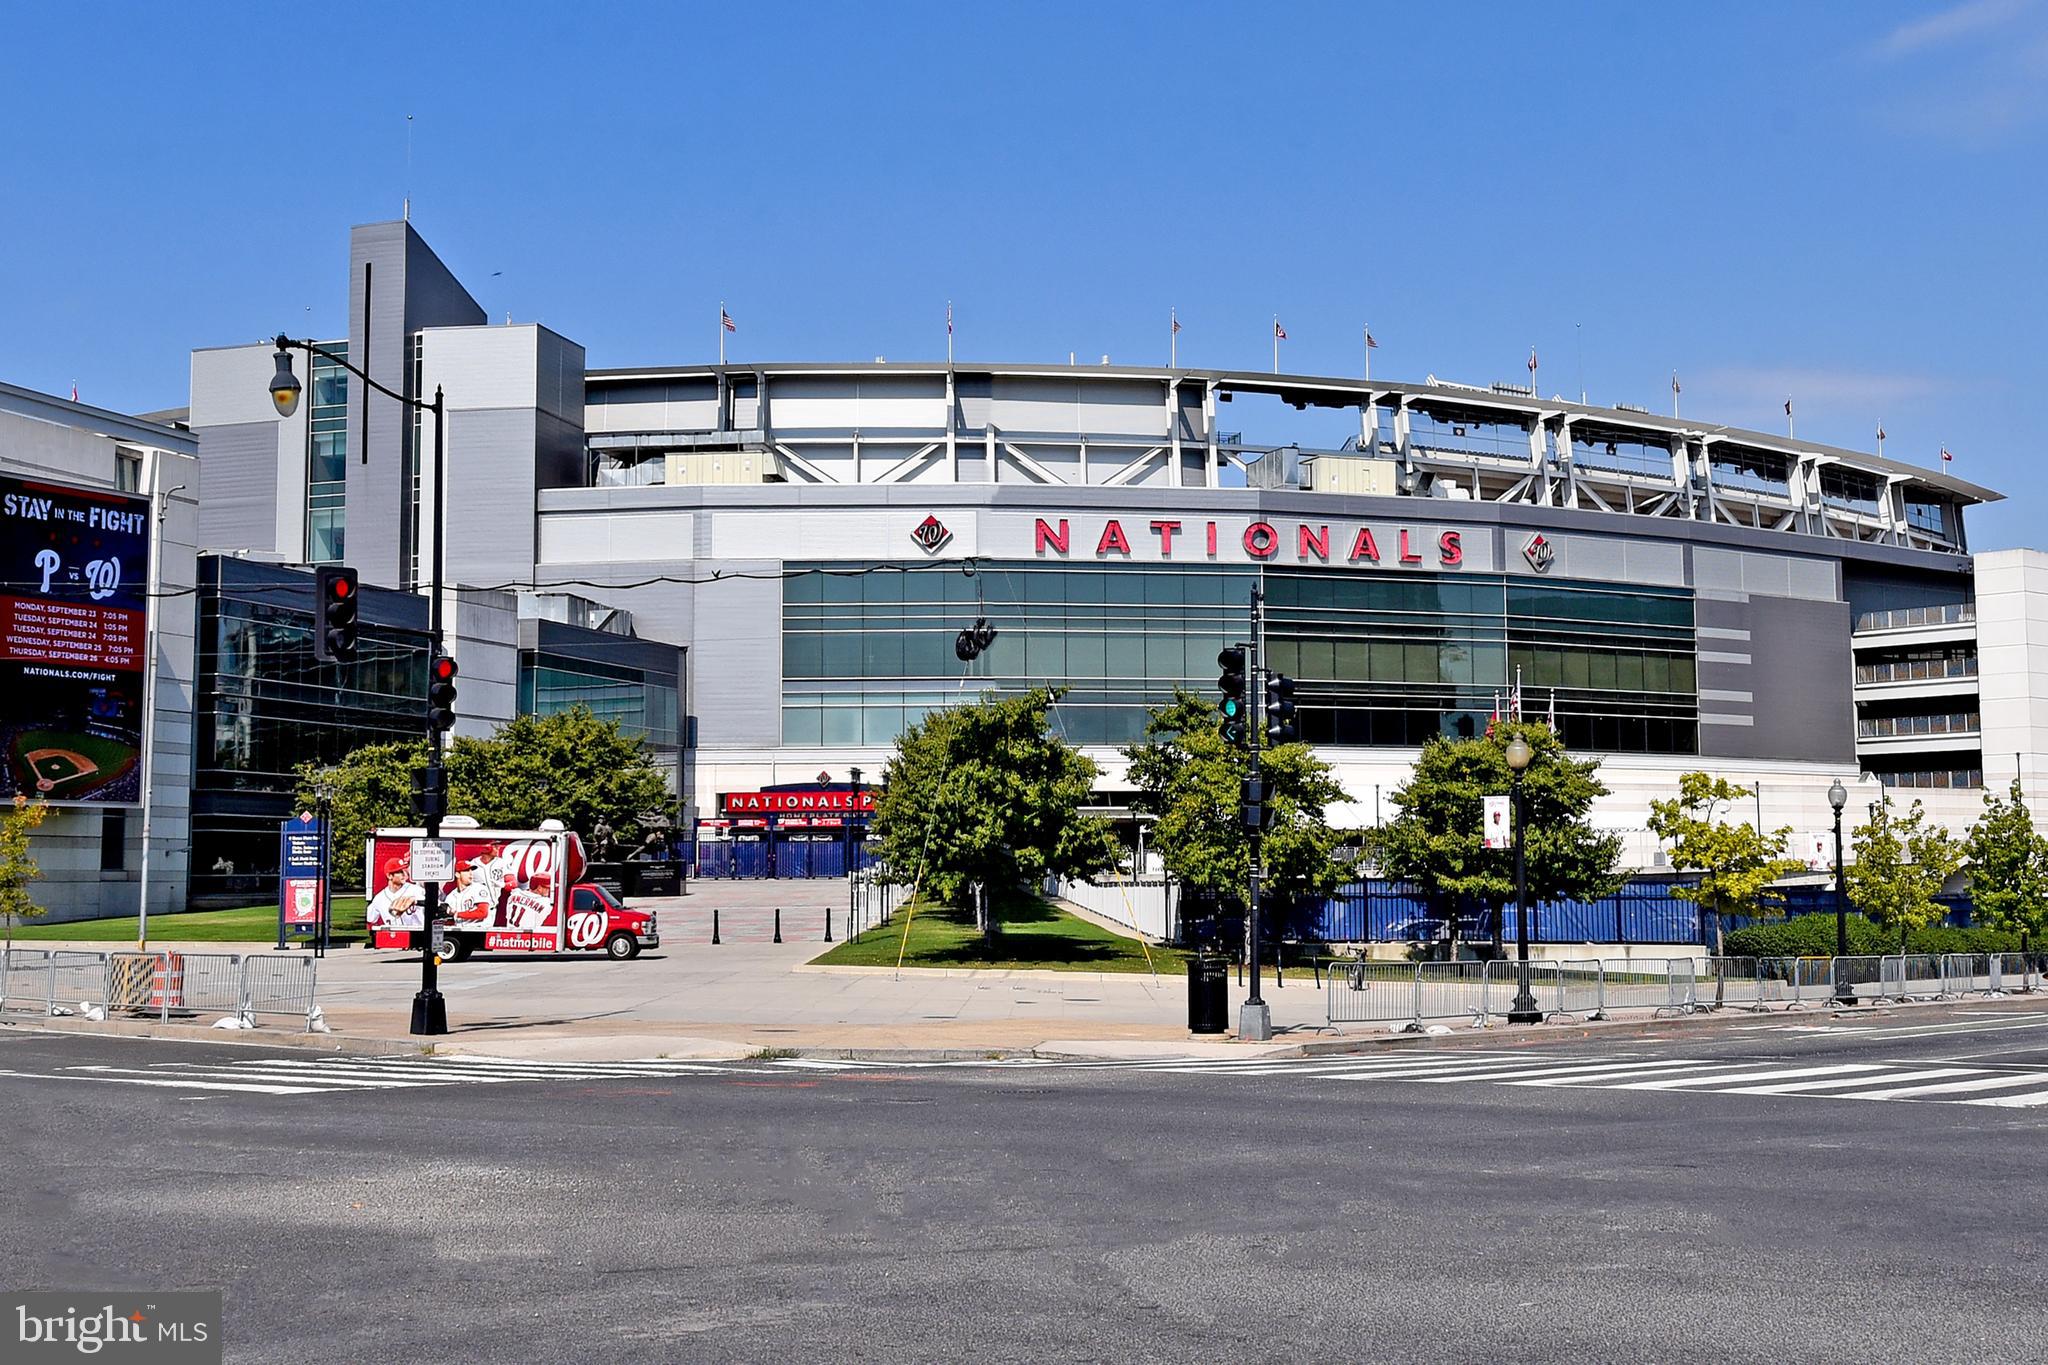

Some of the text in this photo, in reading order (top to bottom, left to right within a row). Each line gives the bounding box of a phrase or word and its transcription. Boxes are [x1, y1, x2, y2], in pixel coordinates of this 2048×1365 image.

[4, 493, 145, 535] STAY IN THE FIGHT
[1034, 517, 1463, 565] NATIONALS
[35, 549, 61, 593] P
[14, 601, 128, 621] MONDAY, SEPTEMBER 23 7:05 PM
[14, 612, 47, 624] TUESDAY,
[48, 616, 88, 628] SEPTEMBER
[118, 624, 128, 632] PM
[12, 624, 128, 643] TUESDAY, SEPTEMBER 24 7:05 PM
[6, 635, 134, 654] WEDNESDAY, SEPTEMBER 25 7:05 PM
[9, 646, 47, 658] THURSDAY,
[48, 650, 88, 662] SEPTEMBER
[104, 655, 118, 664] 4:05
[120, 656, 130, 664] PM
[23, 666, 116, 682] NATIONALS.COM/FIGHT
[732, 795, 853, 808] NATIONALS
[567, 912, 609, 948] W
[488, 936, 553, 950] #natmobile
